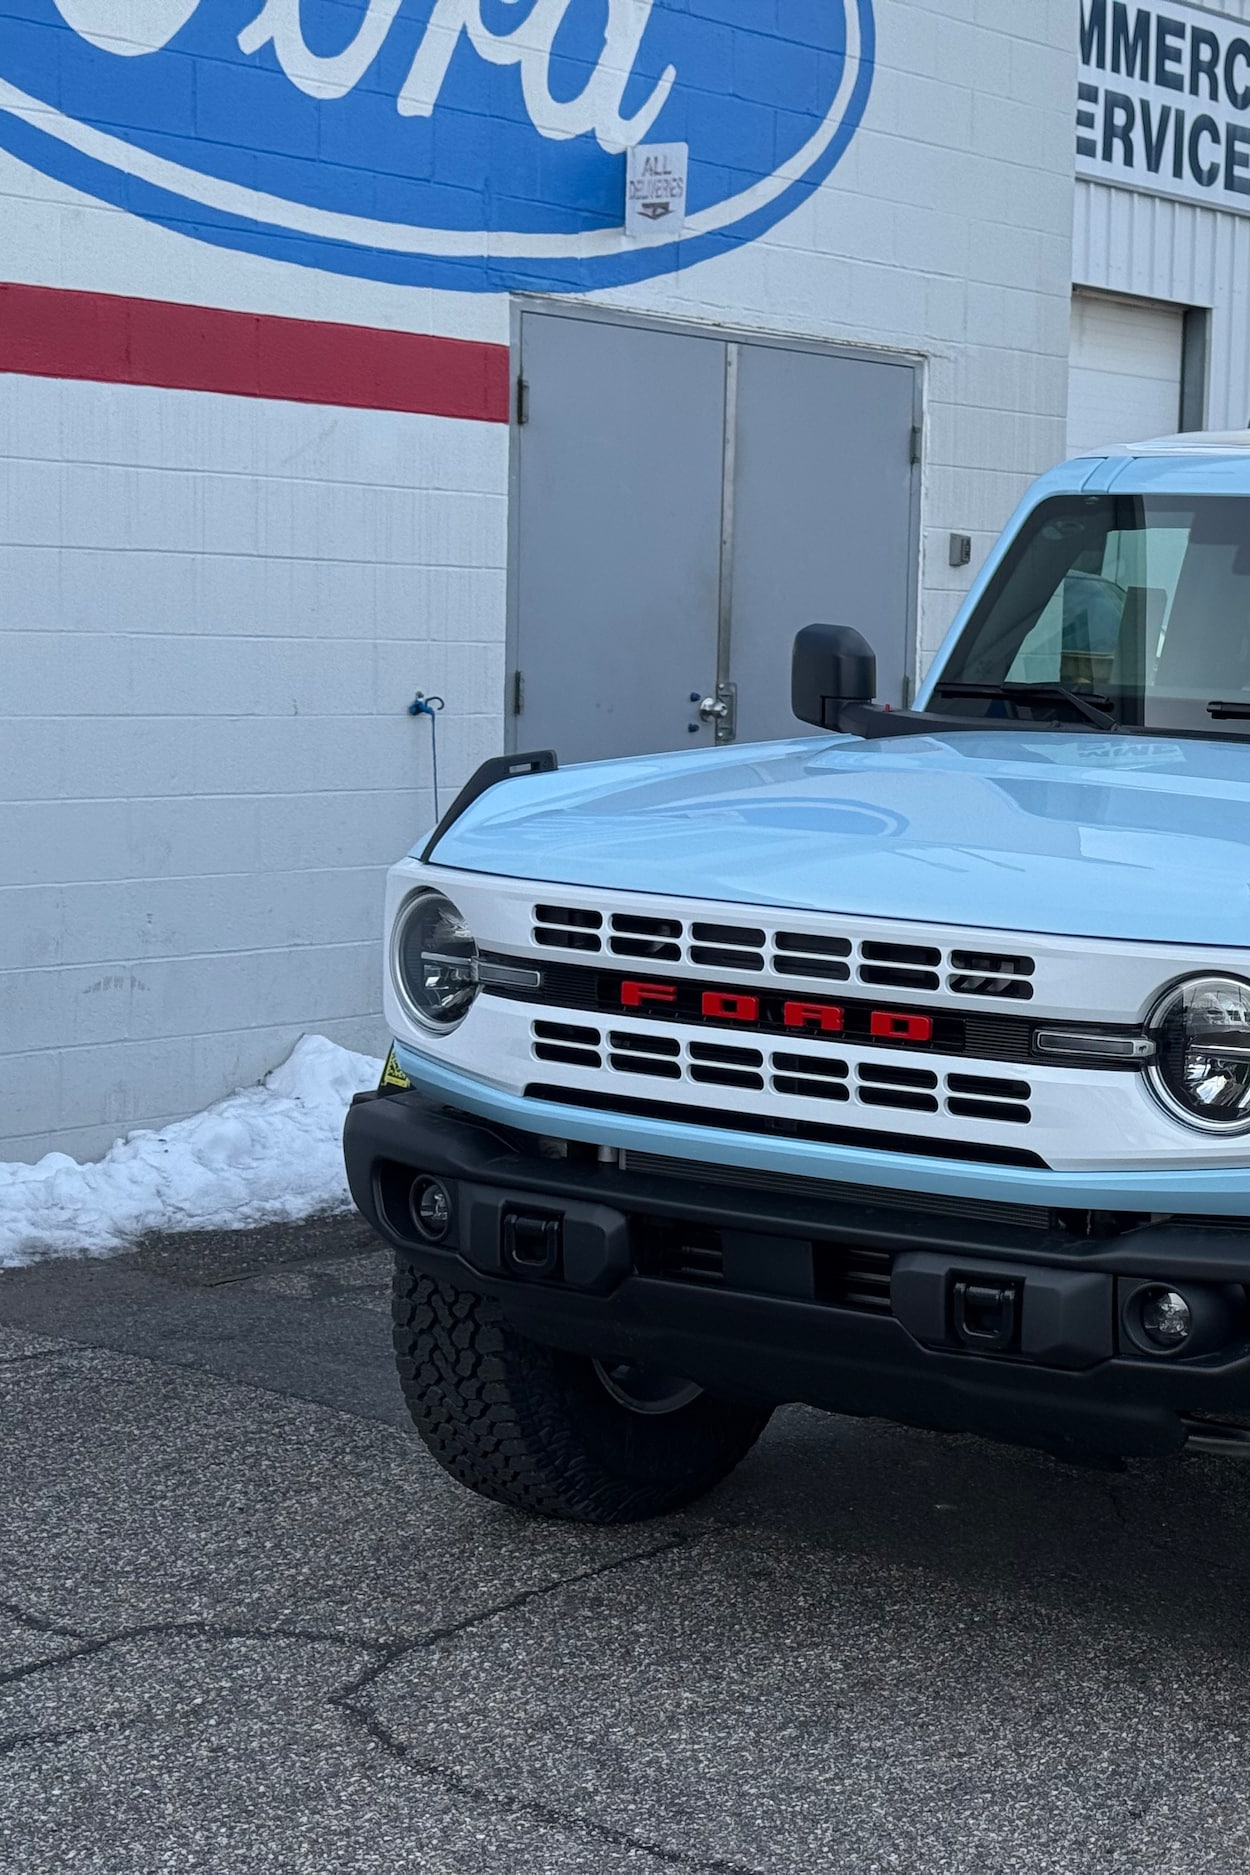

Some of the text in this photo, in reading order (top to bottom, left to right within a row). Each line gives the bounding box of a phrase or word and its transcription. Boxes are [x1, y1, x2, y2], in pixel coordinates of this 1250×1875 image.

[54, 0, 677, 154] ord
[641, 155, 672, 176] ALL
[620, 980, 934, 1042] FORD
